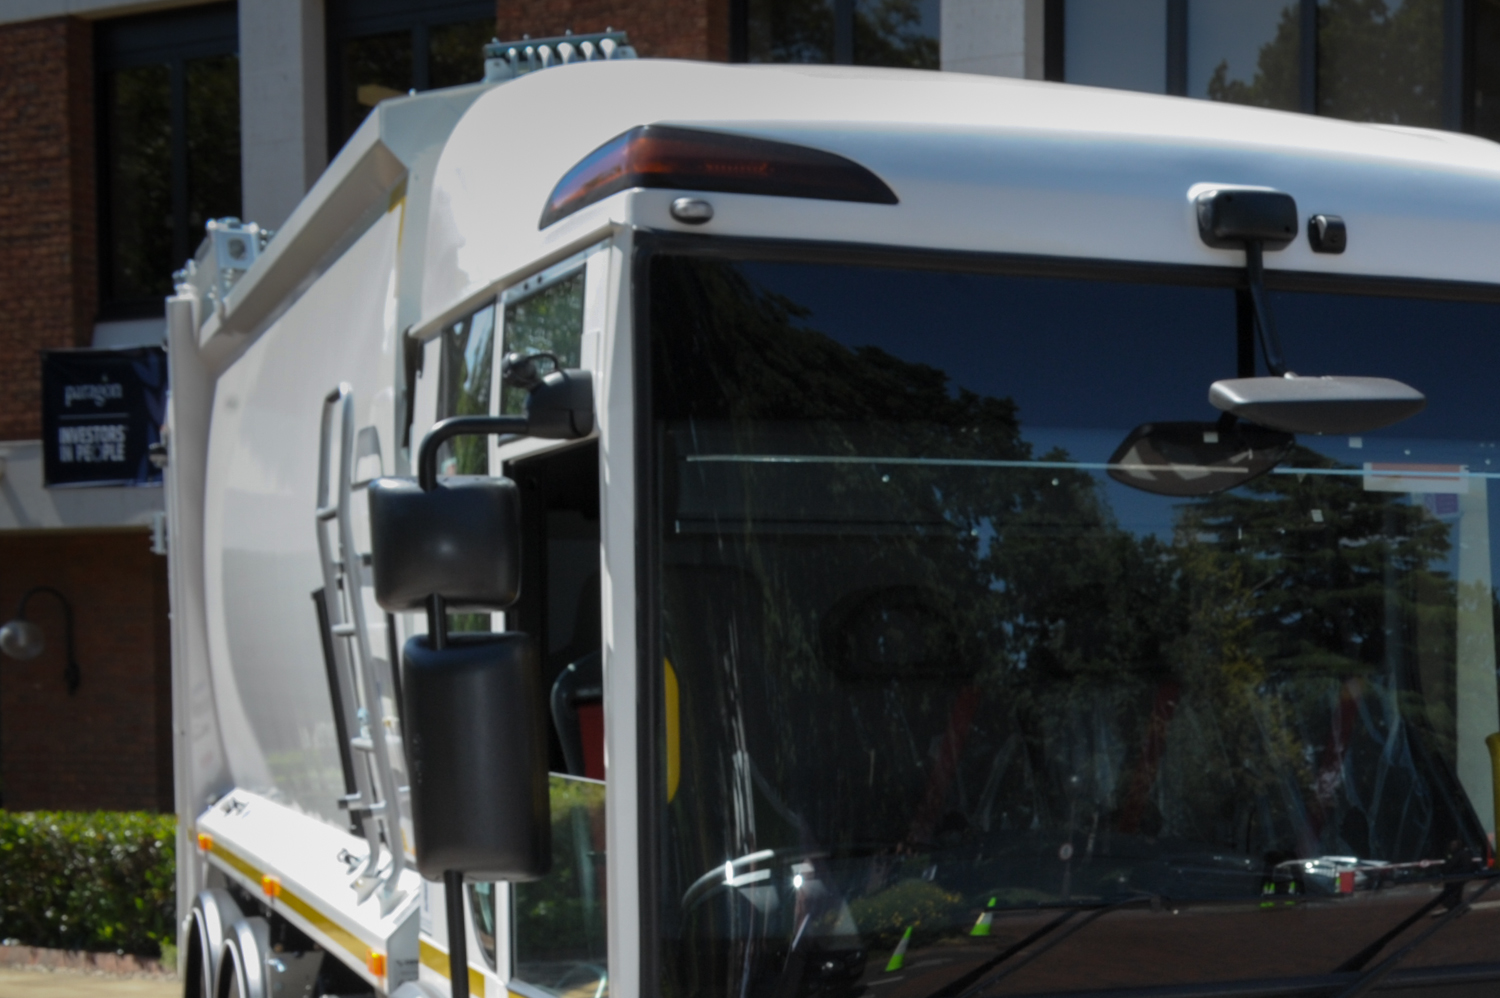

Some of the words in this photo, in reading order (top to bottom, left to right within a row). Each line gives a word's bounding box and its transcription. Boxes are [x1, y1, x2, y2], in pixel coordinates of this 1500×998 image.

[64, 383, 123, 407] paragon
[58, 424, 126, 444] INVESTORS
[59, 444, 74, 463] IN
[75, 443, 126, 462] PEOPLE
